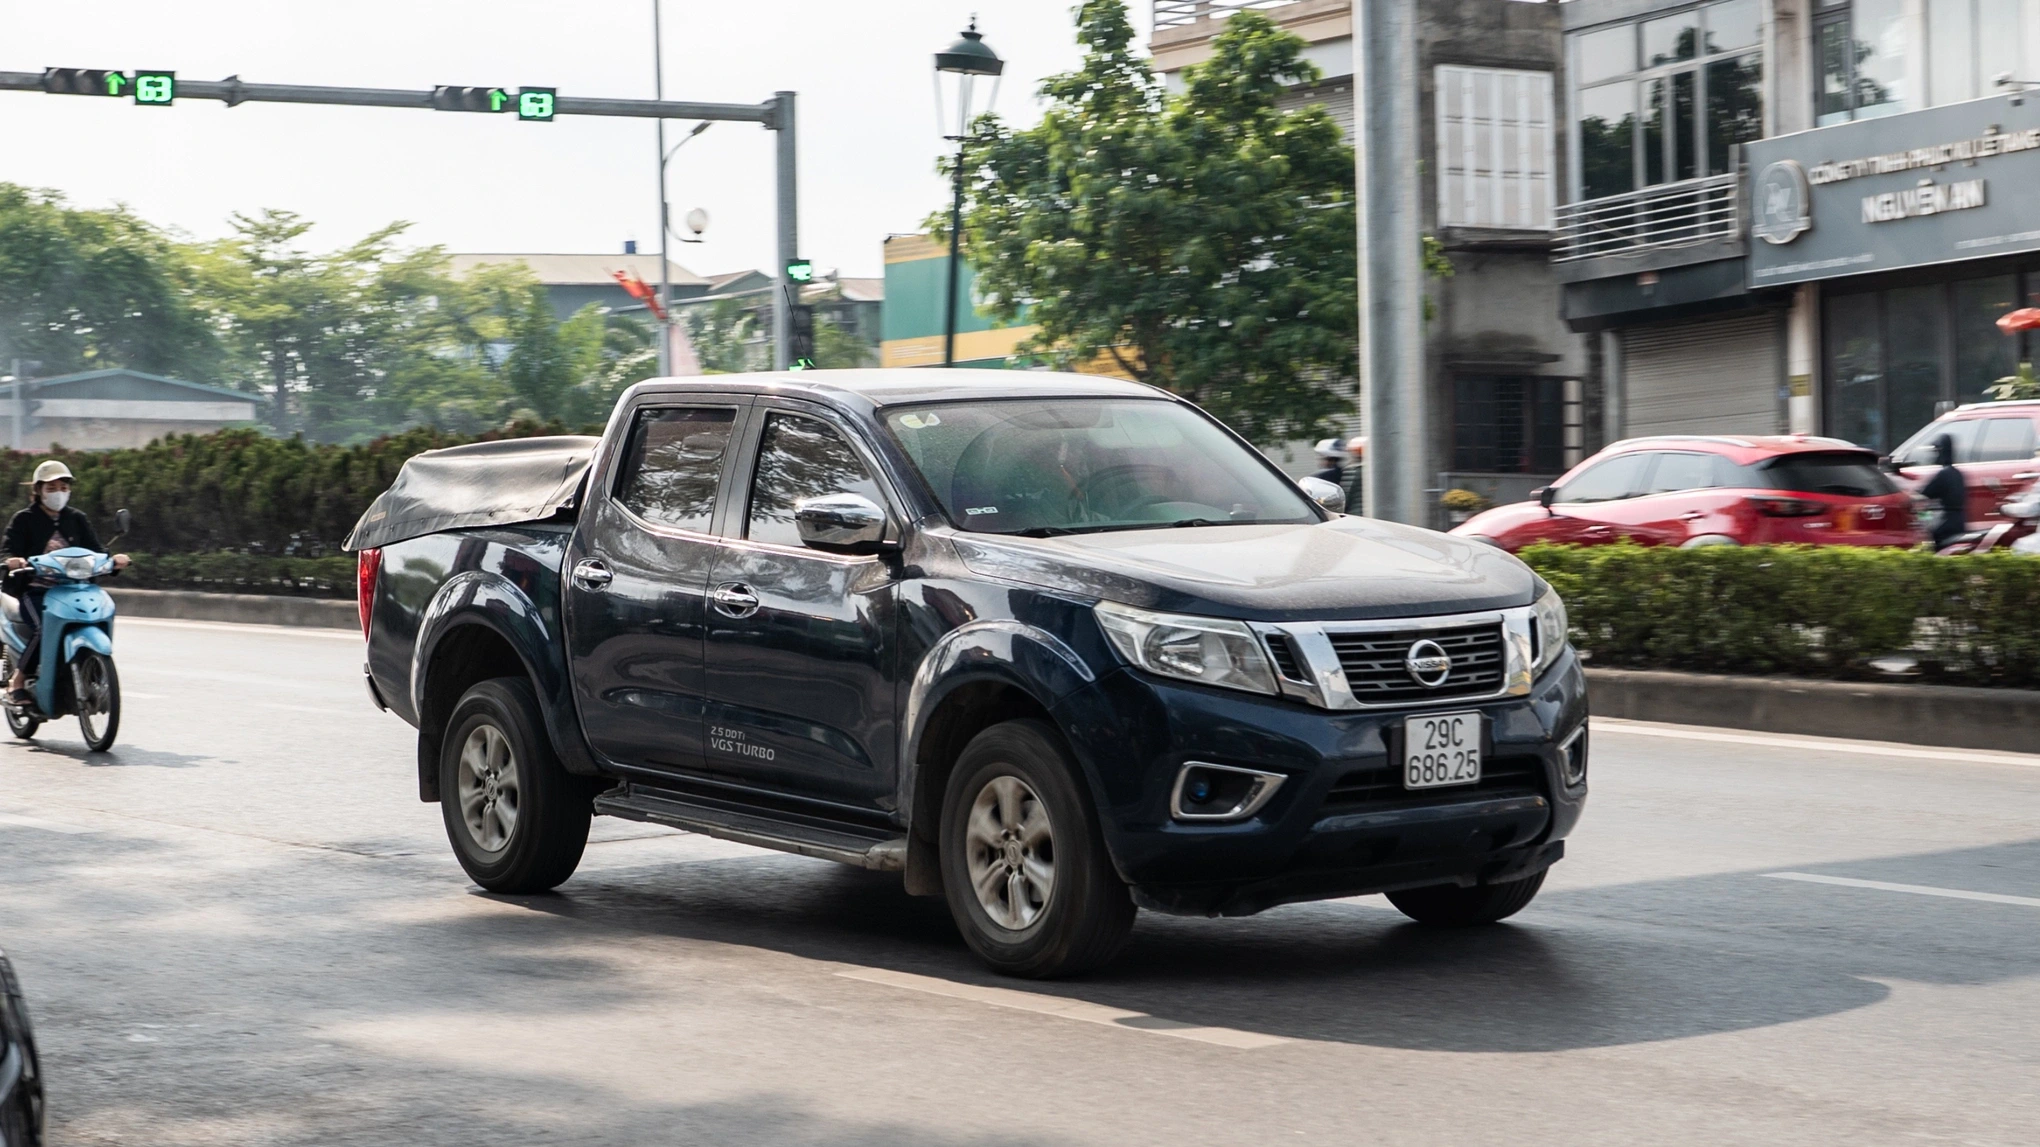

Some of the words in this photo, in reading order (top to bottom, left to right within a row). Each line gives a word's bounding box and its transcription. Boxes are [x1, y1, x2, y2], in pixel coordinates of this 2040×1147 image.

[136, 75, 173, 102] 63
[1424, 717, 1463, 749] 29C
[710, 737, 734, 753] VGS
[735, 742, 775, 761] TURBO
[1408, 749, 1478, 784] 686.25
